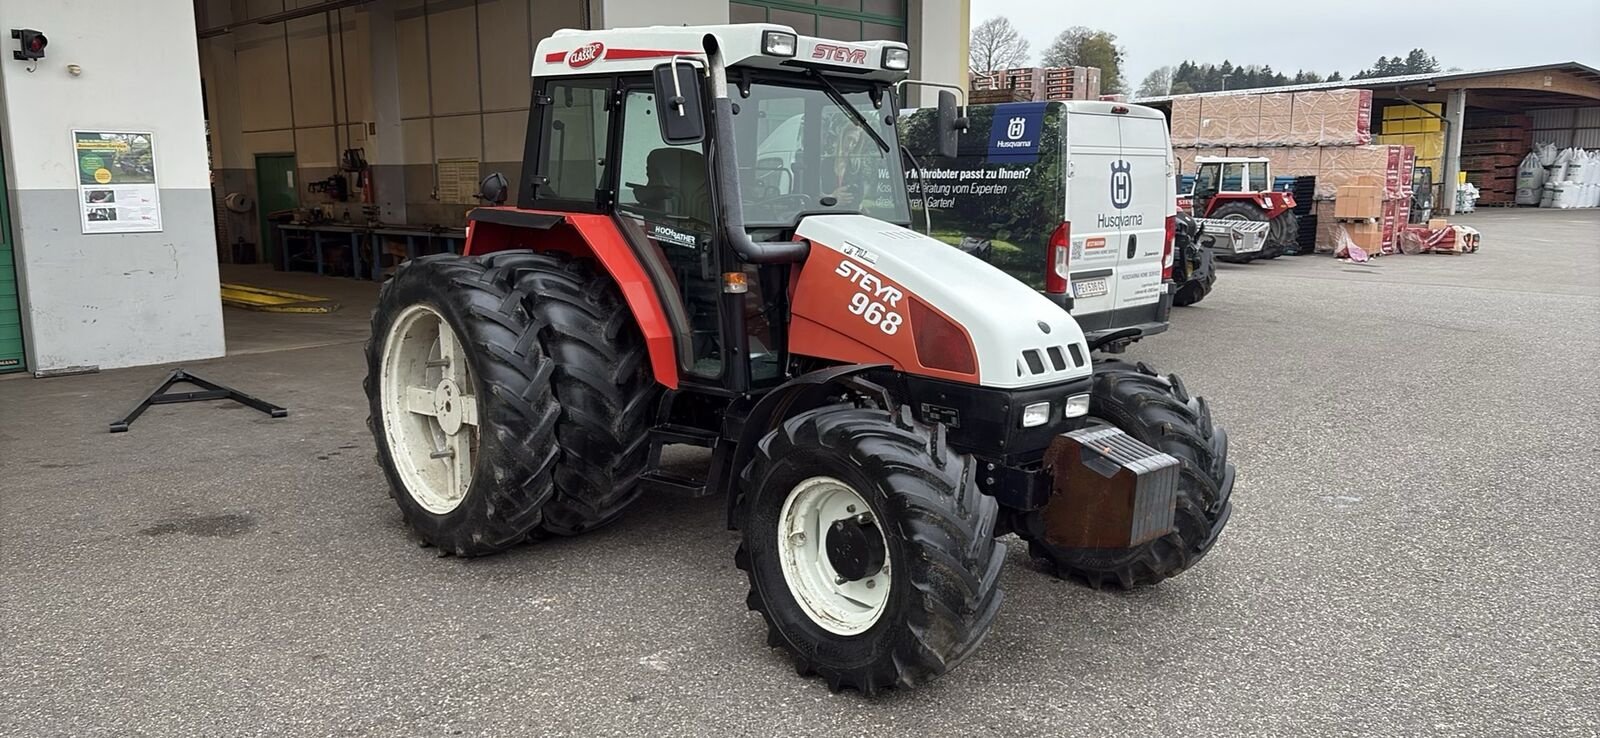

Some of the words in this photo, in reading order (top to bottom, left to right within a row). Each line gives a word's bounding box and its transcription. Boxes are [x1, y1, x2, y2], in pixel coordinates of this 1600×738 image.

[570, 48, 596, 63] CLASSIC
[812, 43, 868, 65] STEYR
[996, 140, 1032, 149] Husqvarna
[960, 168, 985, 181] passt
[985, 170, 997, 179] zu
[998, 167, 1031, 179] Ihnen?
[952, 184, 969, 194] vom
[970, 182, 1008, 196] Experten
[927, 196, 956, 208] Garten!
[1097, 213, 1143, 229] Husqvarna
[834, 258, 904, 309] STEYR
[847, 291, 904, 336] 968
